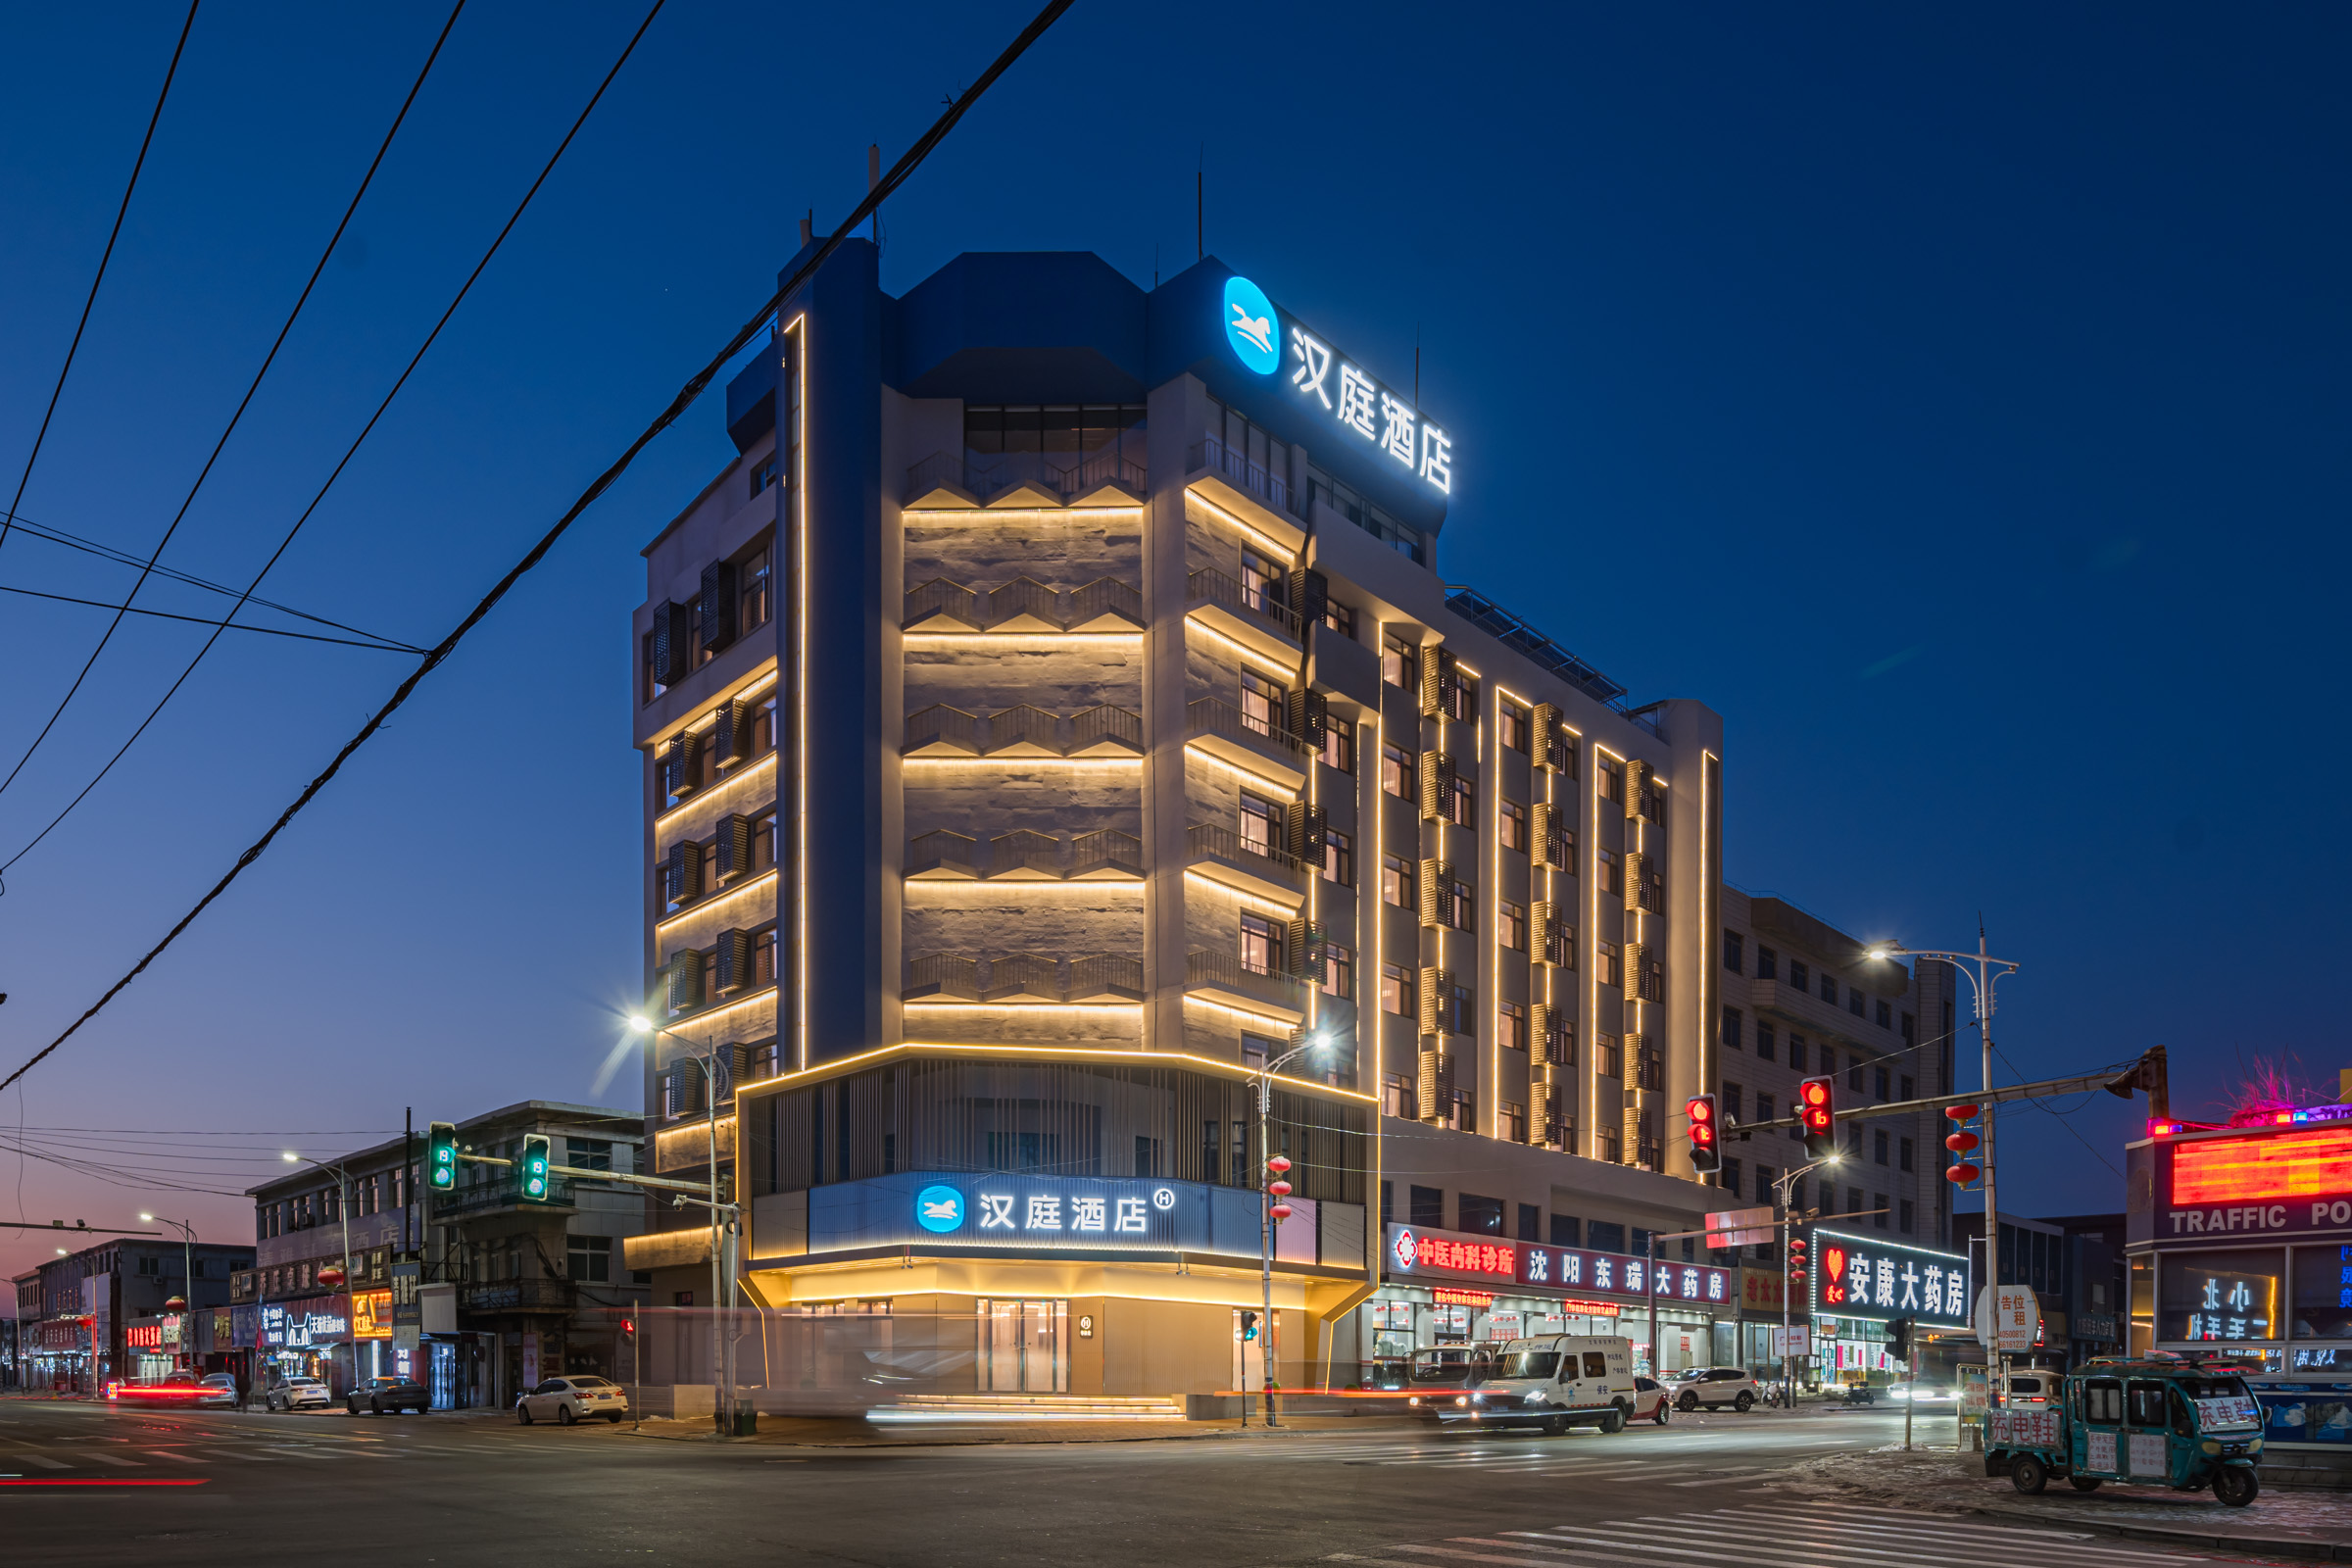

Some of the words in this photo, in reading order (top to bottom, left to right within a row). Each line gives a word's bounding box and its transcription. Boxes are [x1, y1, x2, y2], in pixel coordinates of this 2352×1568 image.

[1292, 326, 1451, 495] 汉庭酒店
[979, 1193, 1148, 1233] 汉庭酒店
[2169, 1204, 2287, 1234] TRAFFIC
[2311, 1200, 2352, 1226] PO
[1417, 1237, 1515, 1275] 中医内科诊所
[1529, 1250, 1722, 1299] 沈阳东瑞大药房
[1848, 1252, 1965, 1316] 安康大药房
[1827, 1285, 1843, 1303] 爱心
[1998, 1295, 2026, 1310] 告位
[1998, 1330, 2026, 1339] 40500812
[1596, 1385, 1608, 1396] 保安
[1992, 1411, 2055, 1444] 充电鞋
[2198, 1398, 2258, 1428] 充电鞋
